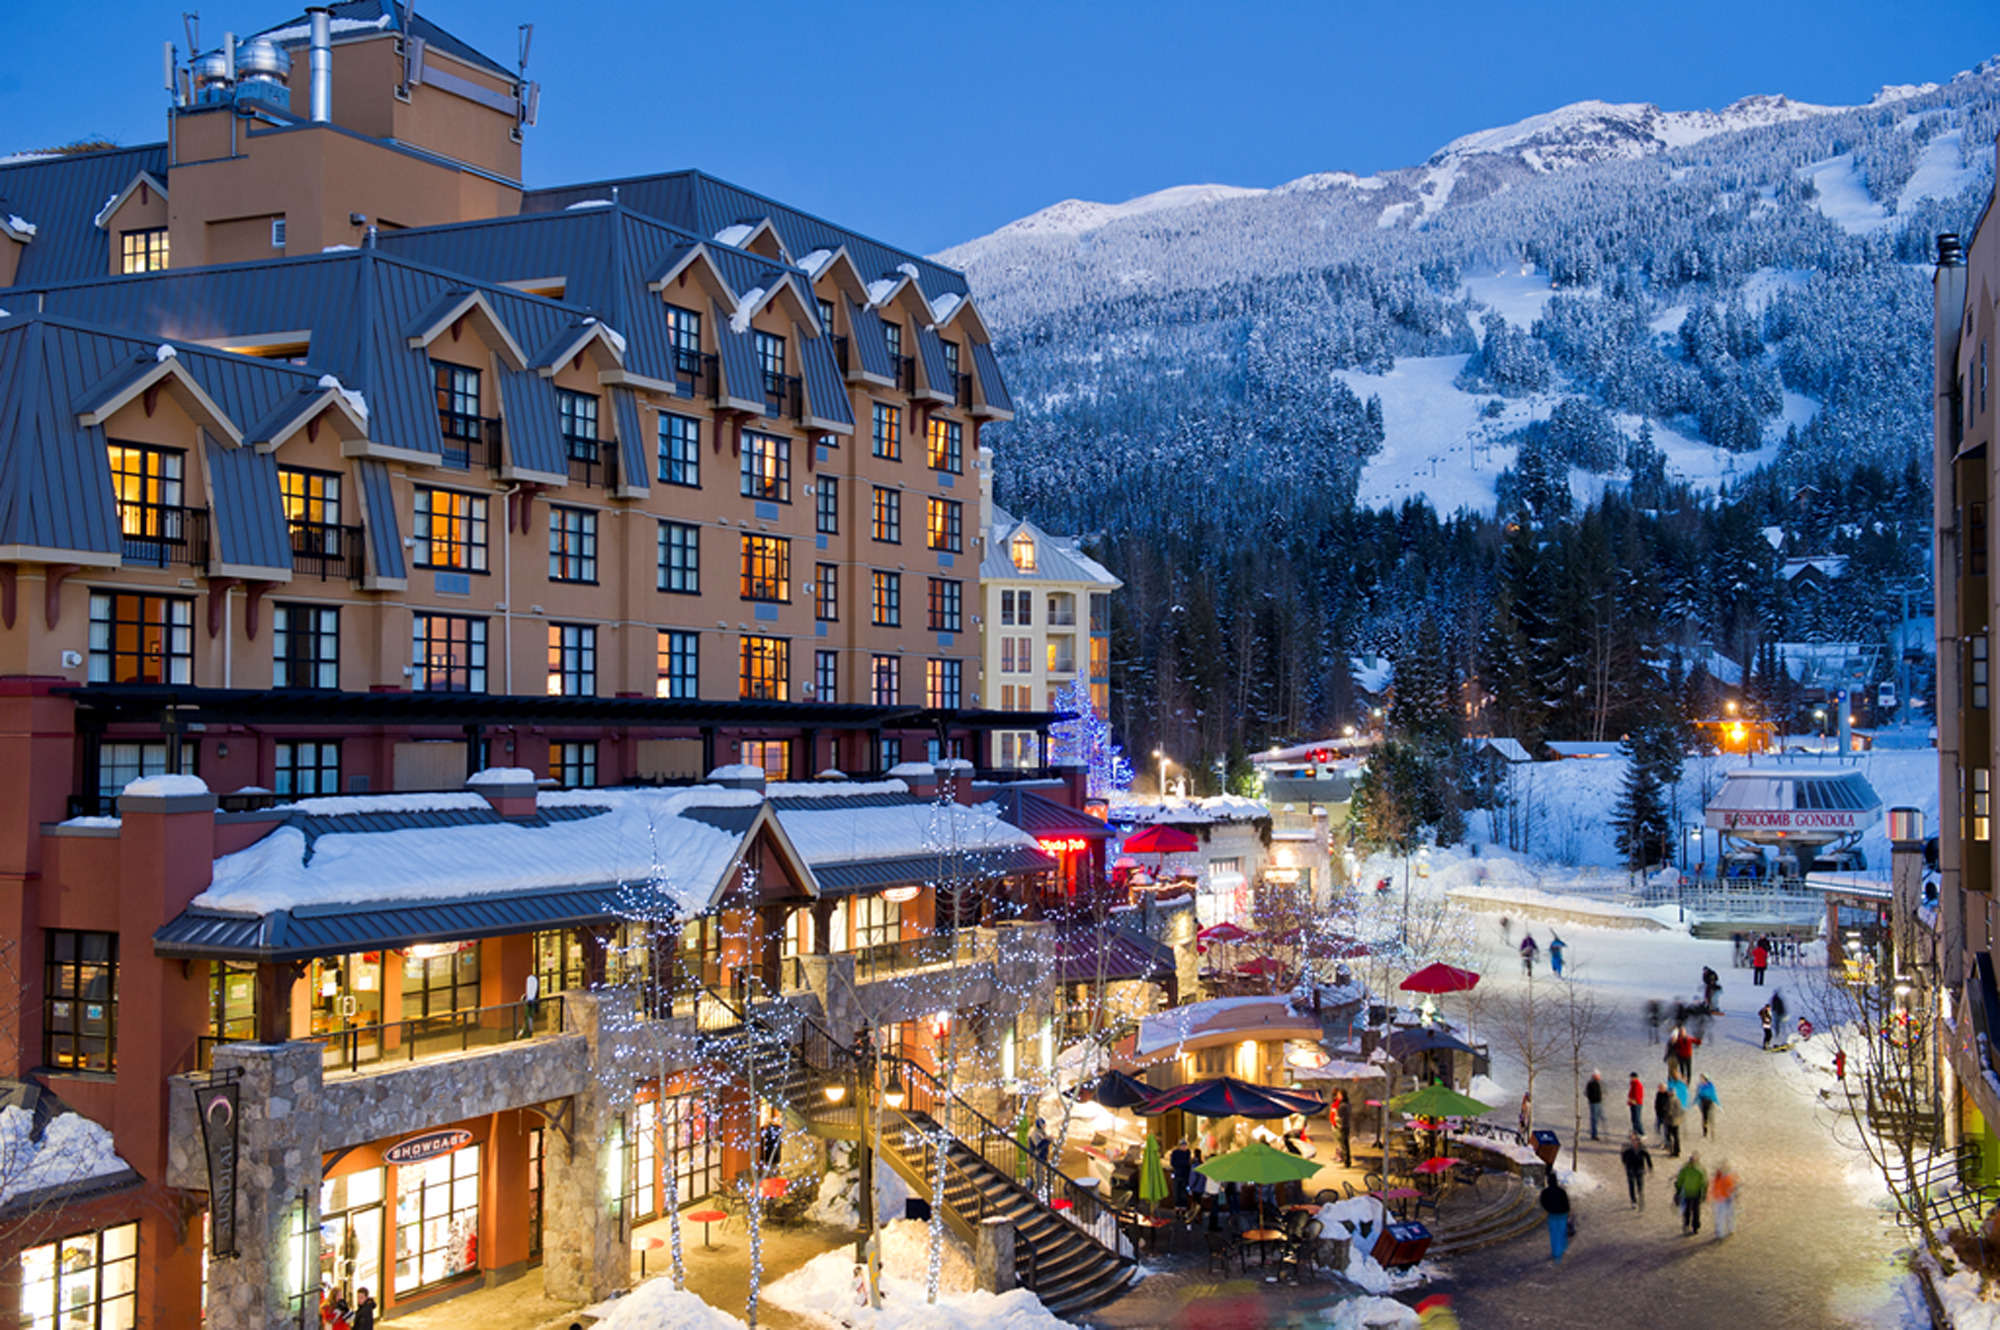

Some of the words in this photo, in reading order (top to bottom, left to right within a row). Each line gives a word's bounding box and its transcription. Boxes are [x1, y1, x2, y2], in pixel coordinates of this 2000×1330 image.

[1724, 813, 1791, 827] BCKCOMB
[1795, 813, 1855, 827] GONDOLA
[392, 1133, 467, 1159] SHOWCASE
[217, 1144, 232, 1233] SUNDIAL
